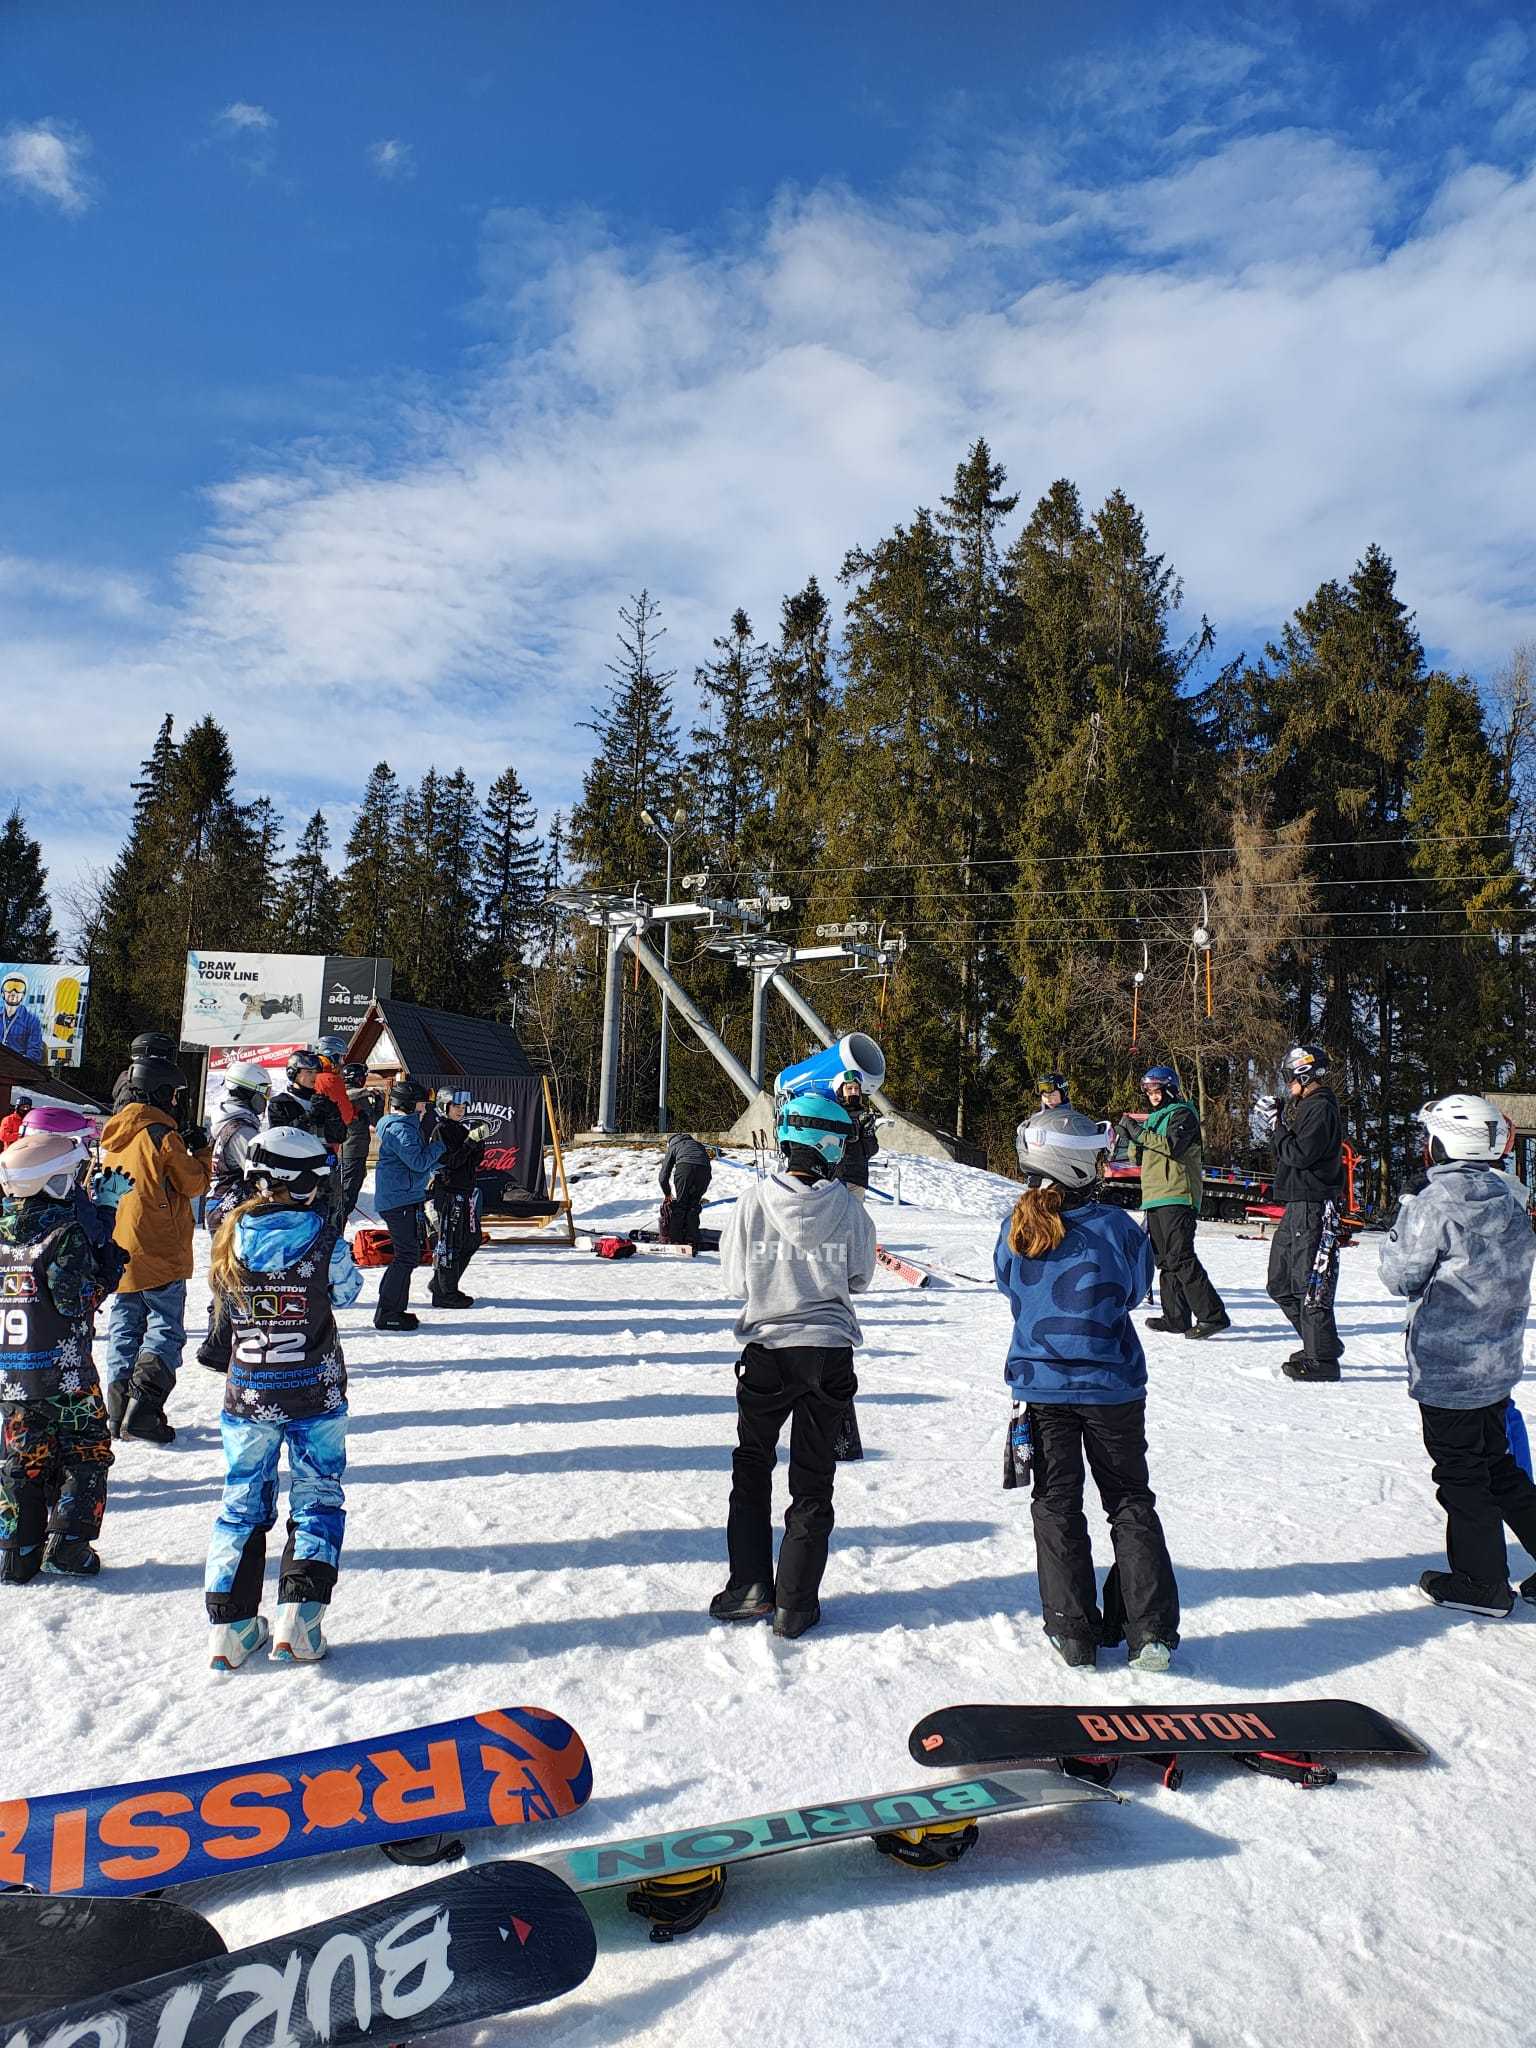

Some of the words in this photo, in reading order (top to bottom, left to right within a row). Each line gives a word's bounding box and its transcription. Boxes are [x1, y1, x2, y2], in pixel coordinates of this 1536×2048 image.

[198, 961, 236, 970] DRAW
[198, 970, 231, 980] YOUR
[233, 972, 259, 981] LINE
[329, 993, 350, 1005] a4a
[328, 1015, 364, 1024] KRUPÓW
[333, 1024, 359, 1032] ZAKOP
[467, 1102, 515, 1121] DANIEL'S
[235, 1327, 307, 1364] 22
[1077, 1712, 1277, 1742] BURTON
[597, 1782, 998, 1879] BURTON
